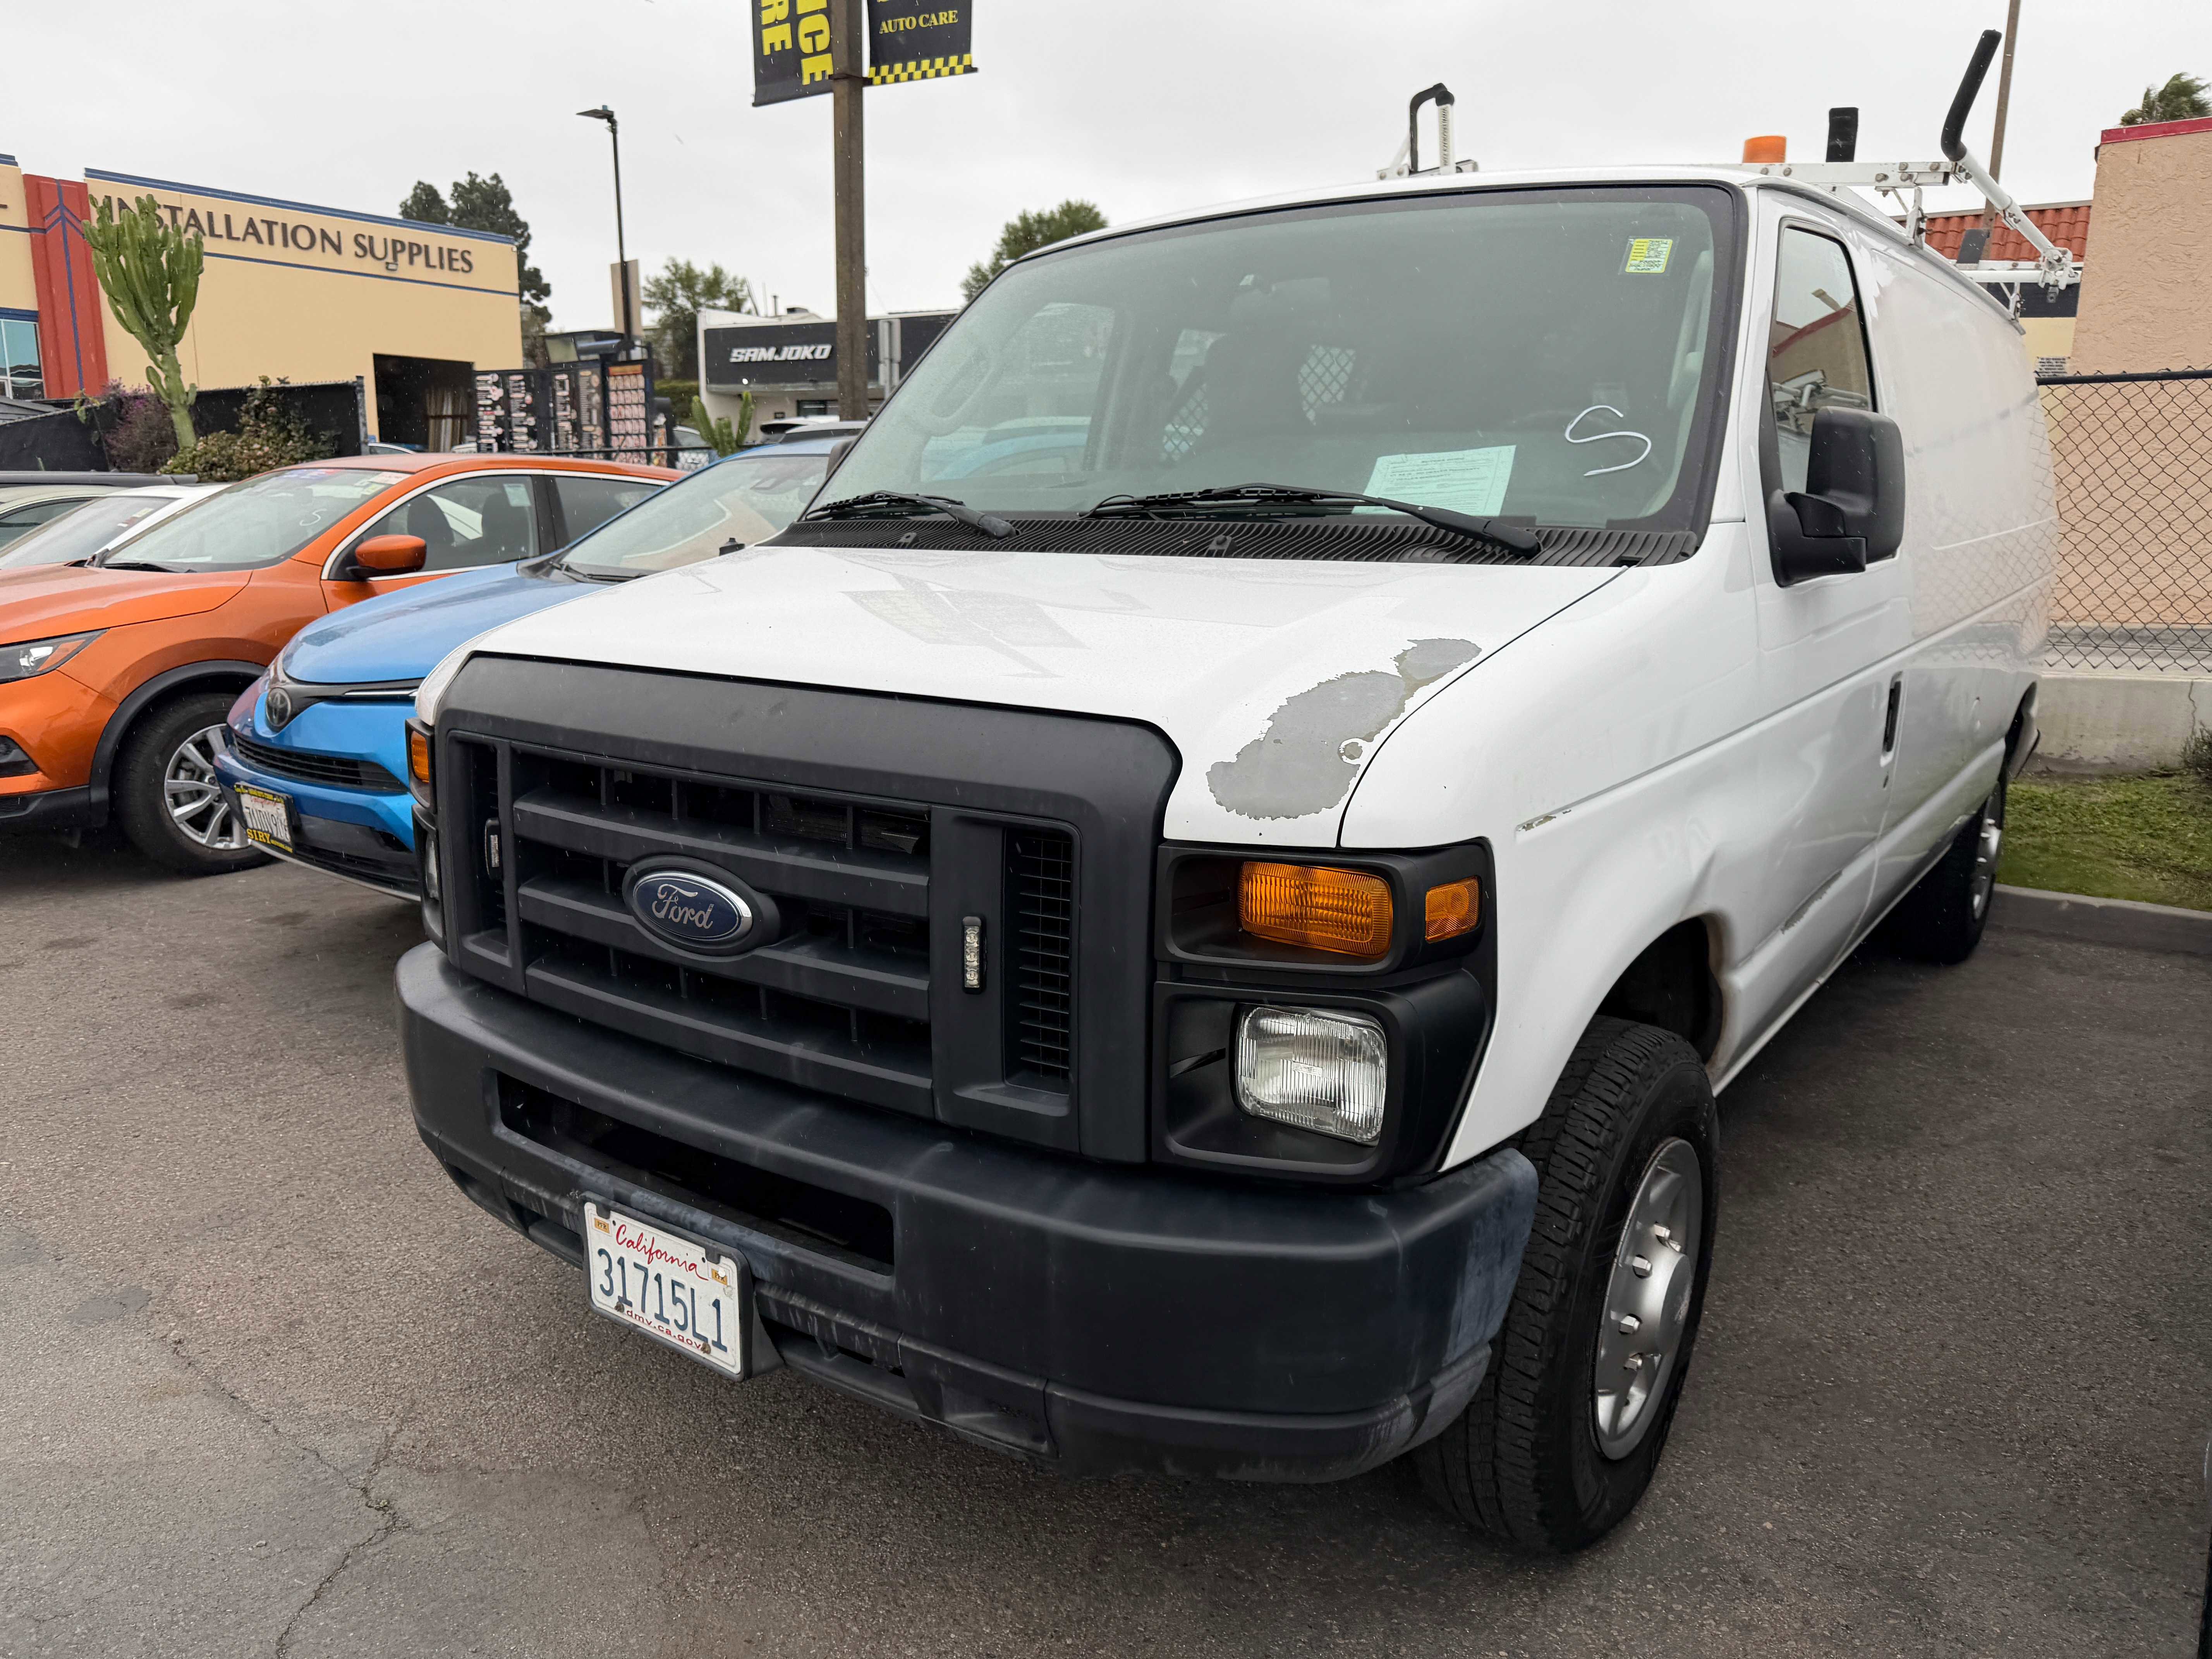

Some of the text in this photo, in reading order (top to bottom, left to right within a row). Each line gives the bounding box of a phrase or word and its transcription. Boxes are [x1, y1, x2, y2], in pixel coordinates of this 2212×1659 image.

[879, 10, 958, 34] AUTO CARE
[353, 233, 474, 273] SUPPLIES
[730, 343, 832, 363] SAMJOKO
[652, 883, 714, 929] Ford
[616, 1224, 709, 1281] California
[598, 1248, 728, 1353] 31715L1
[626, 1310, 701, 1349] dmv.ca.gov
